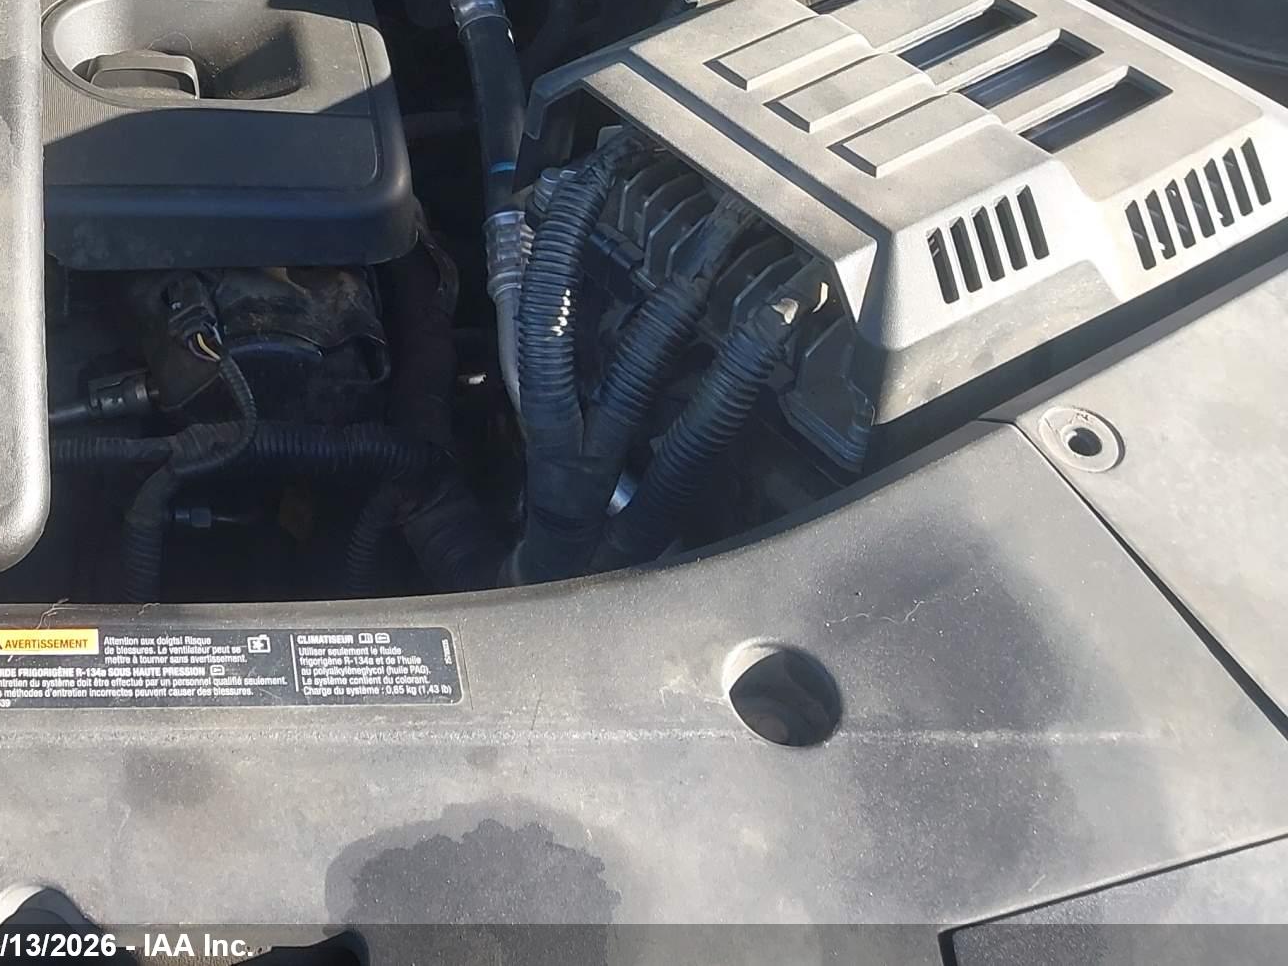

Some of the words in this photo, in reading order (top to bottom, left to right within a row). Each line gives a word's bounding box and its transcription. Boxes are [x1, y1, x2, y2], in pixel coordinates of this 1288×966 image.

[104, 637, 139, 645] Attention
[140, 637, 154, 645] aux
[184, 637, 211, 646] Risque
[297, 635, 354, 644] CLIMATISEUR
[104, 646, 114, 655] de
[116, 646, 156, 655] blessures.
[157, 646, 167, 655] Le
[169, 646, 210, 655] ventilateur
[212, 646, 230, 655] peut
[231, 646, 241, 655] se
[298, 647, 326, 656] Utiliser
[327, 647, 369, 655] seulement
[370, 647, 378, 655] le
[379, 646, 402, 655] fluide
[105, 655, 131, 664] mettre
[132, 655, 138, 664] à
[139, 655, 168, 664] tourner
[169, 655, 189, 664] sans
[190, 655, 247, 663] avertissement.
[344, 656, 374, 665] R-134a
[376, 656, 385, 665] et
[386, 656, 395, 665] de
[18, 666, 74, 677] FRIGORIGÈNE
[75, 667, 106, 677] R-134a
[108, 667, 131, 677] SOUS
[132, 667, 161, 677] HAUTE
[162, 667, 205, 676] PRESSION
[386, 666, 408, 675] (huile
[410, 666, 431, 675] PAG).
[29, 678, 40, 687] du
[76, 678, 92, 687] doit
[93, 678, 109, 687] être
[111, 678, 144, 687] effectué
[145, 678, 159, 688] par
[160, 678, 171, 687] un
[172, 678, 211, 687] personnel
[213, 678, 242, 687] qualifié
[243, 677, 288, 685] seulement.
[302, 677, 312, 685] Le
[349, 677, 380, 685] contient
[382, 677, 393, 685] du
[394, 676, 431, 685] colorant.
[4, 688, 43, 697] méthodes
[44, 688, 87, 697] d'entretien
[89, 688, 132, 697] incorrectes
[134, 688, 167, 698] peuvent
[168, 688, 195, 697] causer
[196, 688, 211, 697] des
[212, 687, 253, 696] blessures.
[303, 686, 332, 697] Charge
[333, 686, 344, 695] du
[406, 686, 417, 696] kg
[441, 686, 452, 695] lb)
